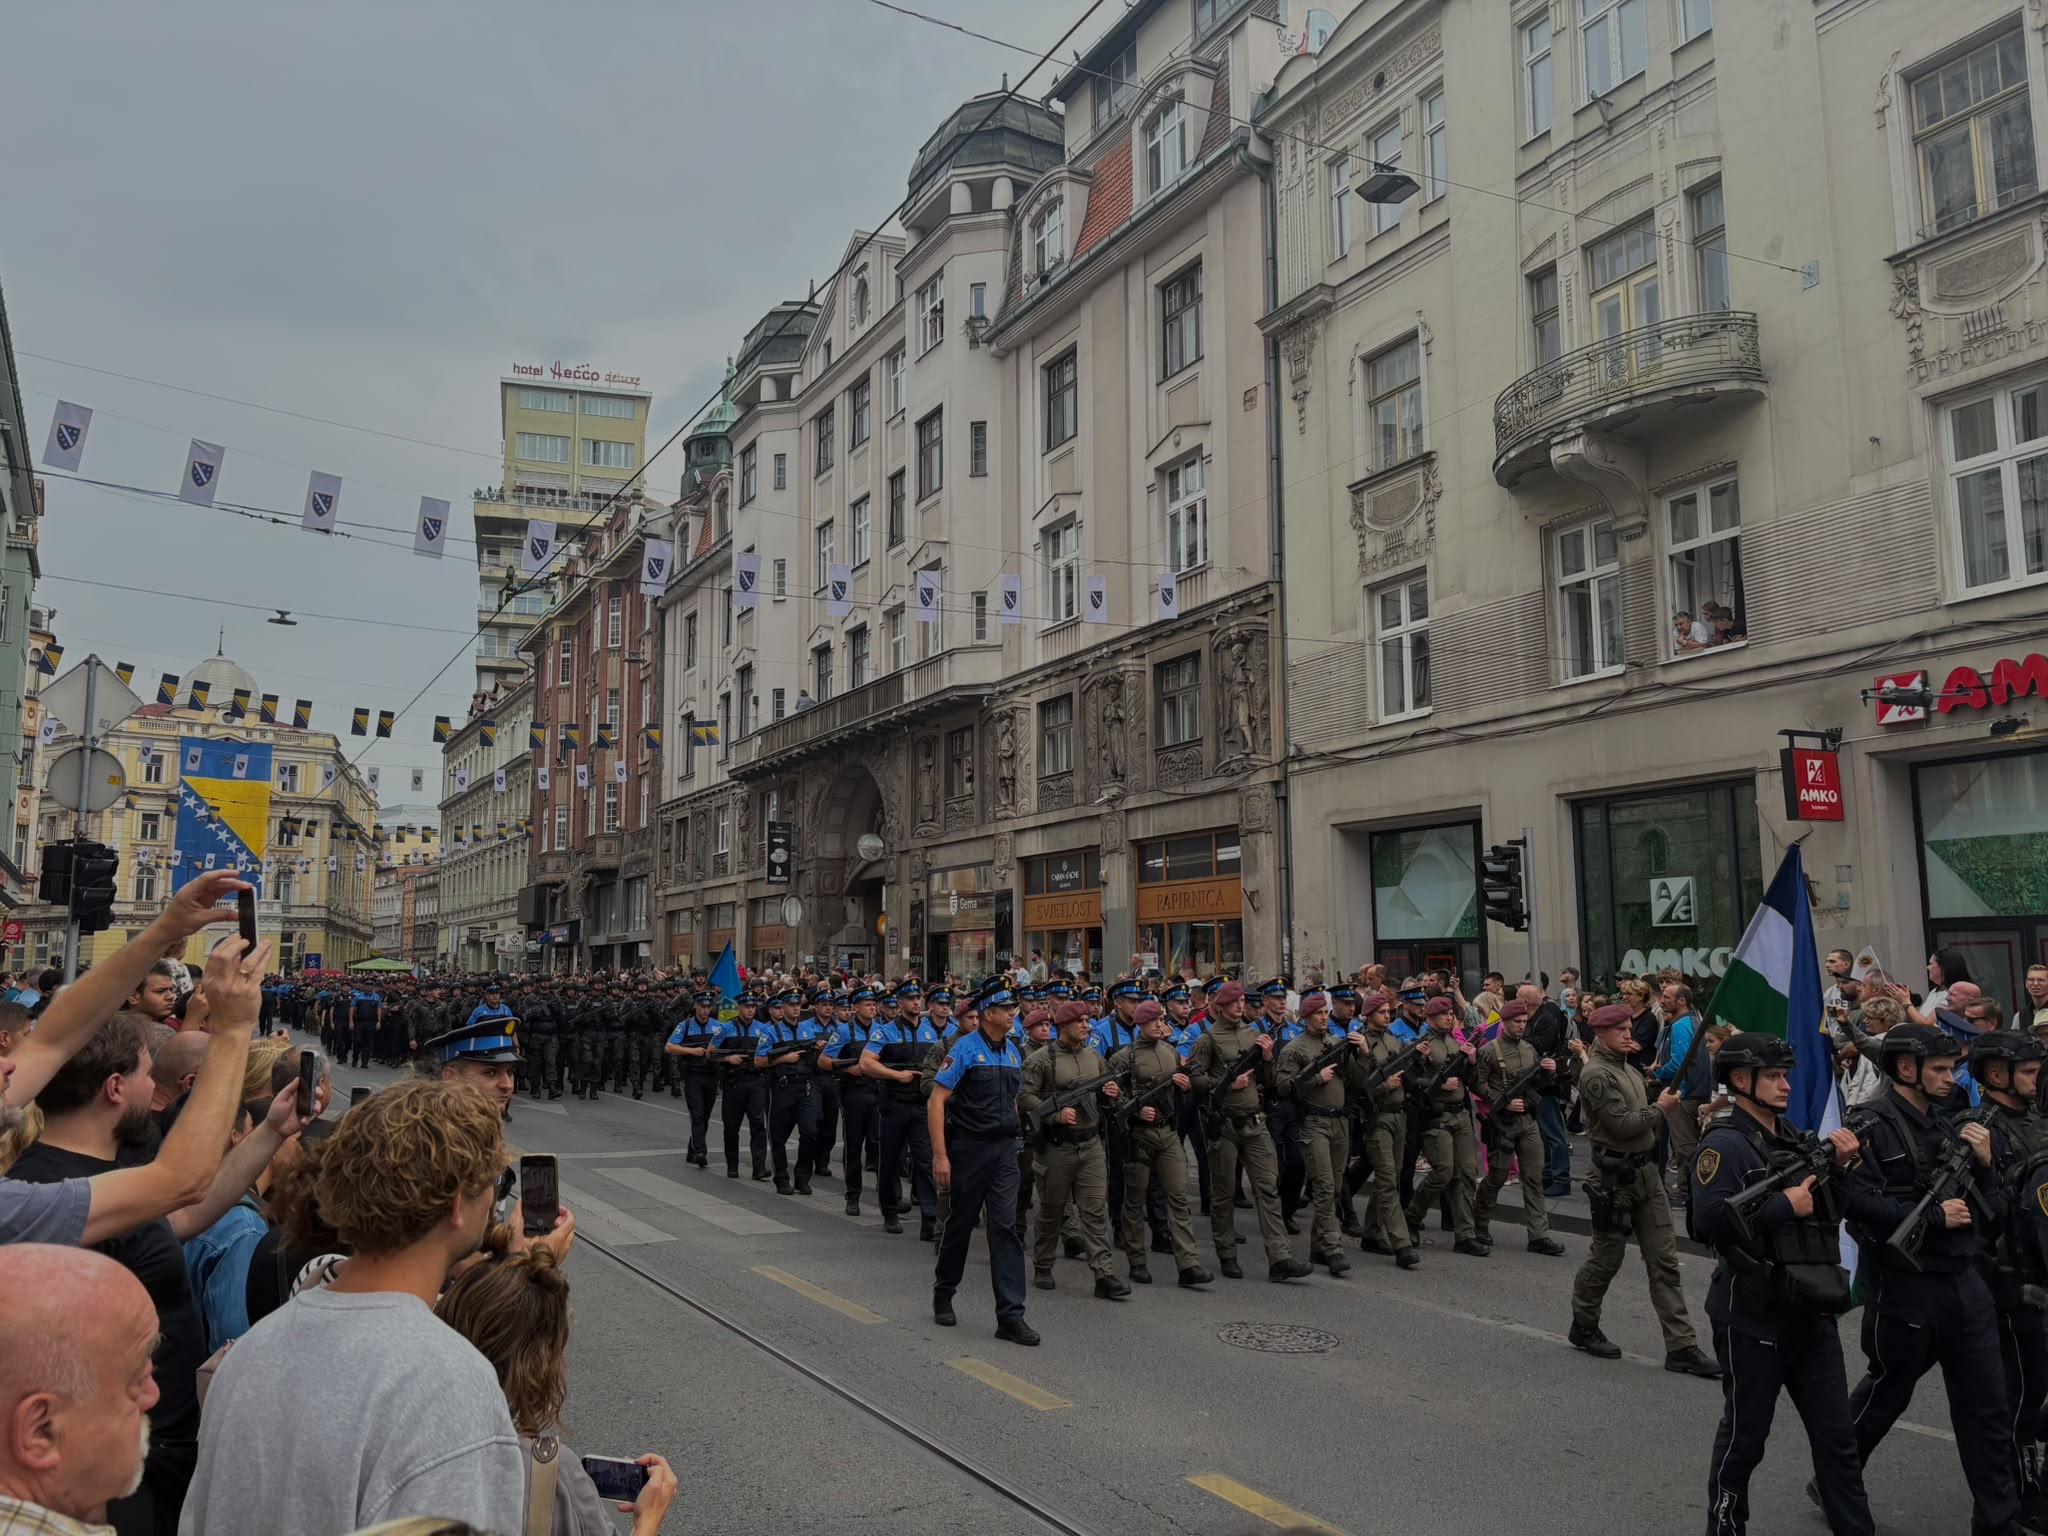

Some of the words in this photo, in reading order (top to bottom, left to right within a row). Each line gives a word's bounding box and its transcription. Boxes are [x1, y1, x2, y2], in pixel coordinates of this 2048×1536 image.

[513, 362, 543, 376] hotel
[604, 371, 641, 386] deluxe
[1800, 788, 1838, 803] AMKO
[959, 898, 977, 910] Gema
[1156, 888, 1225, 911] PAPIRNICA
[1037, 900, 1092, 920] SVJETLOST
